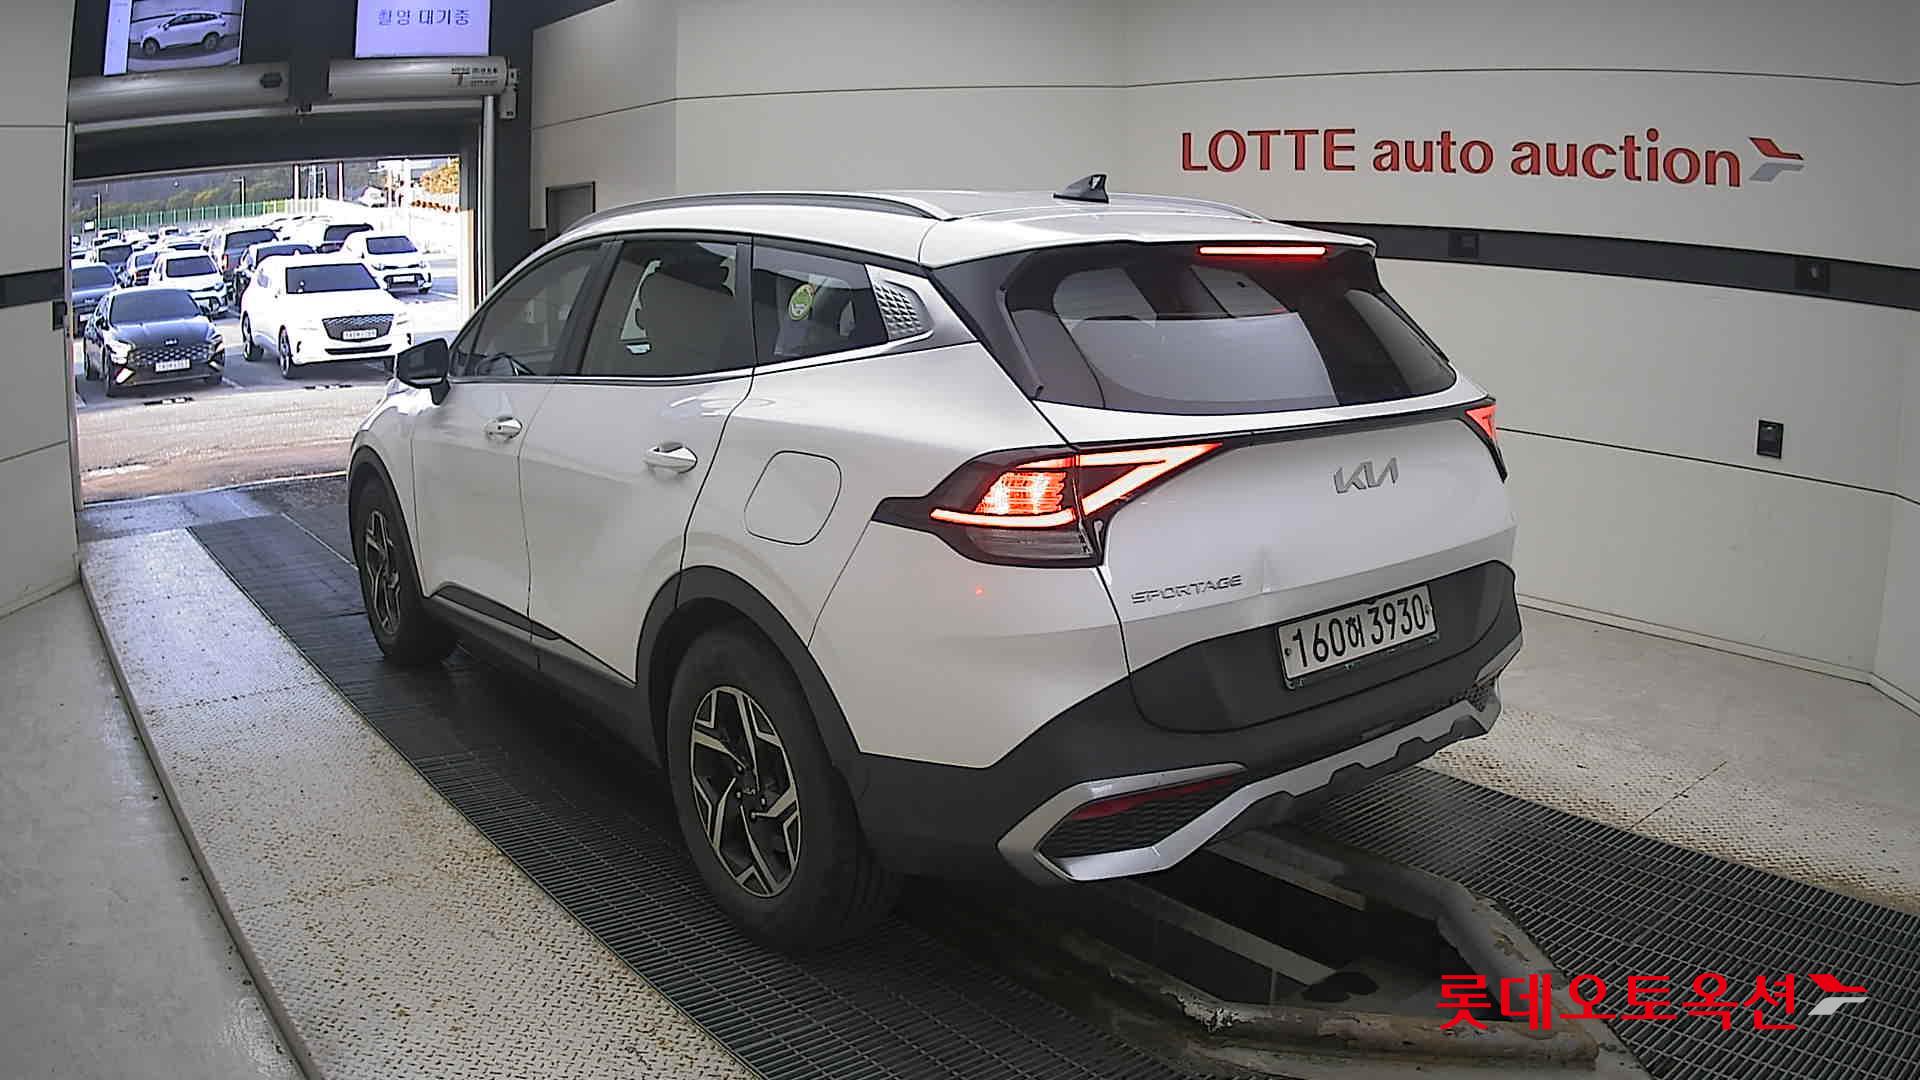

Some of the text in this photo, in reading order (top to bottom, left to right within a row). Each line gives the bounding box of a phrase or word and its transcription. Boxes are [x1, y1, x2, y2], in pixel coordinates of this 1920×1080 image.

[419, 8, 469, 26] 대기중
[1181, 128, 1741, 187] LOTTE auto auction
[1333, 457, 1399, 494] KIA
[1131, 575, 1242, 604] SPORTAGE
[1367, 593, 1427, 645] 3930
